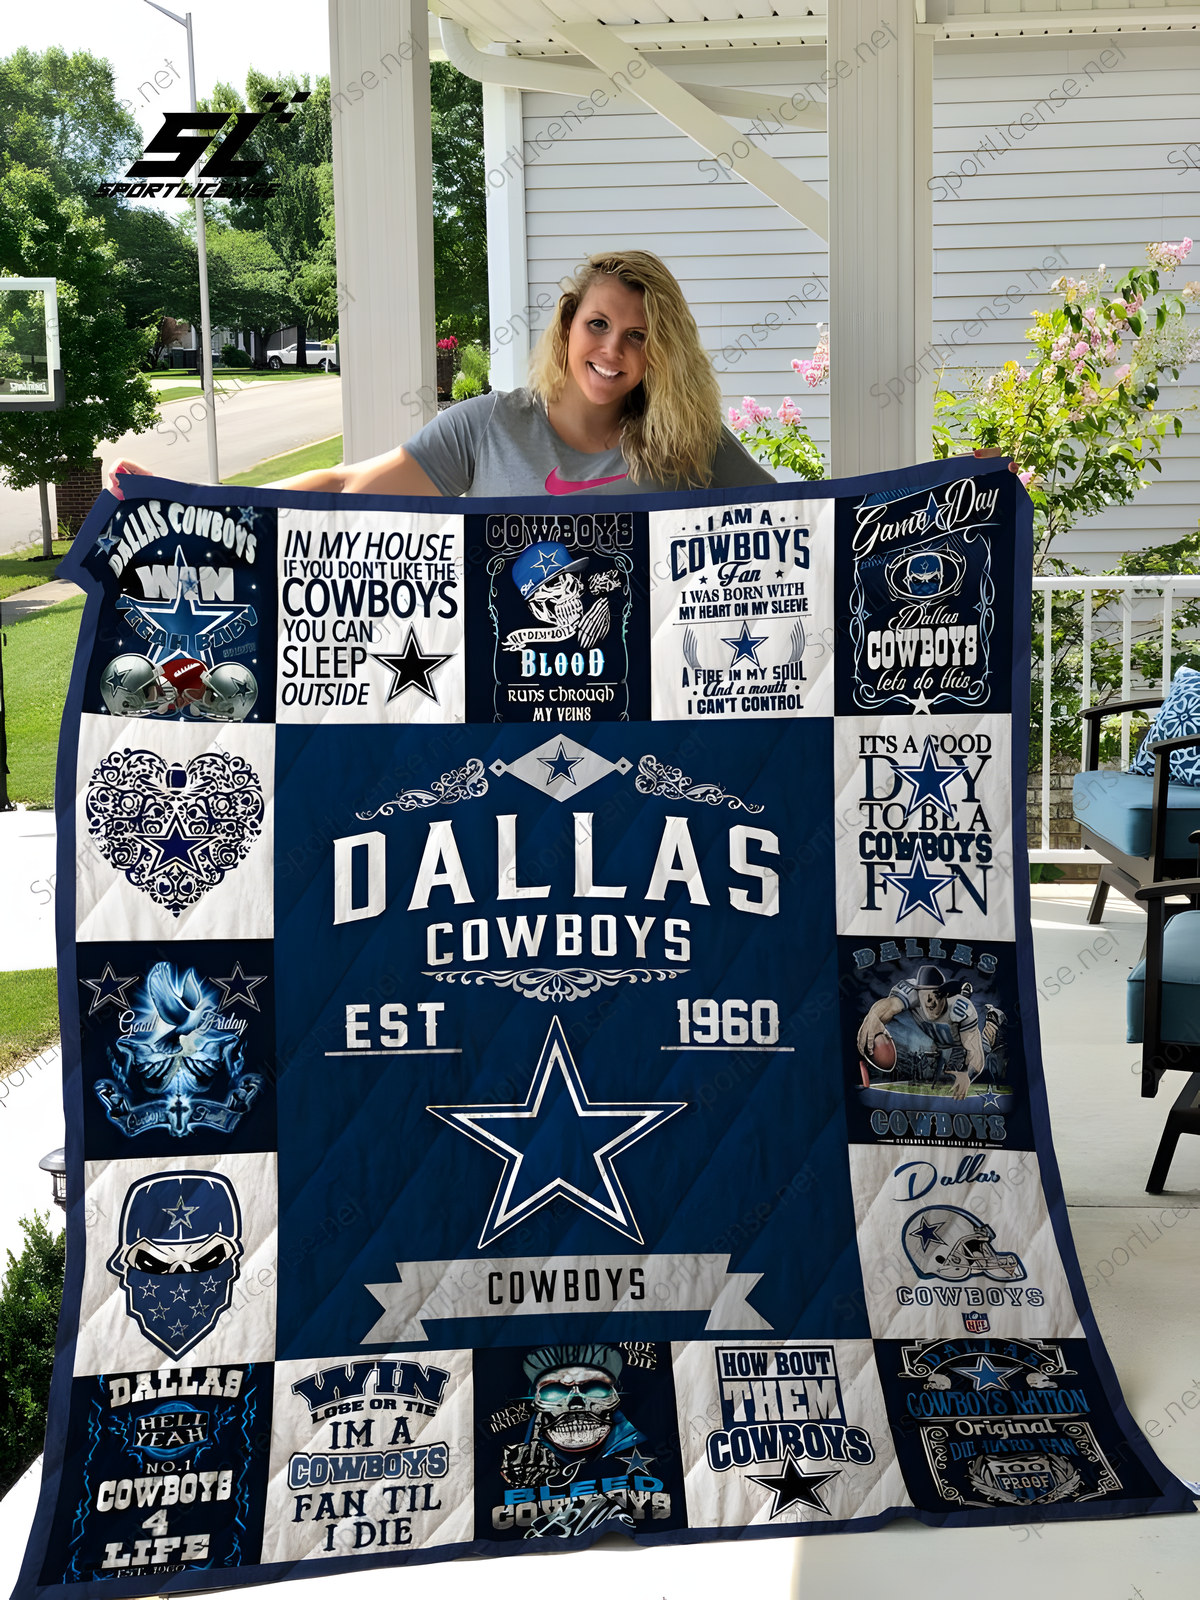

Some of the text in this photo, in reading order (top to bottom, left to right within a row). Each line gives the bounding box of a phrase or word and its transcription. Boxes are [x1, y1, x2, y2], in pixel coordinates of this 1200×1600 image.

[486, 513, 634, 548] COWBOYS
[708, 508, 773, 531] I AM A
[852, 477, 999, 560] Game Day
[108, 500, 257, 578] DALLAS COWBOYS
[284, 530, 455, 561] IN MY HOUSE
[670, 528, 810, 582] COWBOYS
[135, 564, 234, 601] WIN
[284, 560, 456, 580] IF YOU DON'T LIKE THE
[717, 560, 761, 587] Fan
[282, 577, 458, 619] COWBOYS
[681, 582, 805, 604] I WAS BORN WITH
[679, 598, 808, 620] MY HEART ON MY SLEEVE
[888, 605, 959, 634] Dallas
[283, 619, 373, 642] YOU CAN
[282, 645, 367, 678] SLEEP
[867, 624, 978, 670] COWBOYS
[521, 648, 605, 677] BLOOD
[681, 661, 807, 688] A FIRE IN MY SOUL
[703, 679, 787, 697] And a mouth
[914, 668, 934, 690] do
[940, 667, 971, 689] this
[281, 683, 370, 706] OUTSIDE
[688, 694, 804, 714] I CAN'T CONTROL
[533, 707, 552, 721] MY
[903, 735, 919, 754] A
[924, 734, 992, 754] GOOD
[859, 803, 992, 832] TO BE A
[859, 831, 992, 863] COWBOYS
[333, 812, 780, 925] DALLAS
[426, 914, 691, 966] COWBOYS
[853, 938, 998, 974] DALLAS
[118, 1010, 155, 1039] Good
[346, 1002, 445, 1049] EST
[677, 998, 780, 1044] 1960
[871, 1110, 1007, 1141] COWBOYS
[893, 1153, 1001, 1201] Dallas
[488, 1268, 646, 1305] COWBOYS
[896, 1285, 1045, 1307] COWBOYS
[722, 1351, 831, 1376] HOW BOUT
[923, 1340, 1042, 1367] DALLAS
[109, 1367, 243, 1408] DALLAS
[291, 1359, 450, 1412] WIN
[370, 1399, 397, 1410] OR
[404, 1400, 437, 1417] TIE
[722, 1379, 842, 1422] THEM
[907, 1389, 1091, 1418] COWBOYS NATION
[138, 1413, 206, 1430] HELL
[388, 1416, 415, 1445] A
[955, 1418, 1057, 1439] Original
[135, 1427, 204, 1447] YEAH
[706, 1422, 876, 1472] COWBOYS
[288, 1441, 449, 1490] COWBOYS
[97, 1470, 233, 1512] COWBOYS
[504, 1475, 664, 1505] BLEED
[1001, 1475, 1050, 1490] PROOF
[292, 1483, 441, 1522] FAN TIL
[142, 1509, 169, 1536] 4
[323, 1518, 412, 1551] I DIE
[101, 1534, 211, 1569] LIFE
